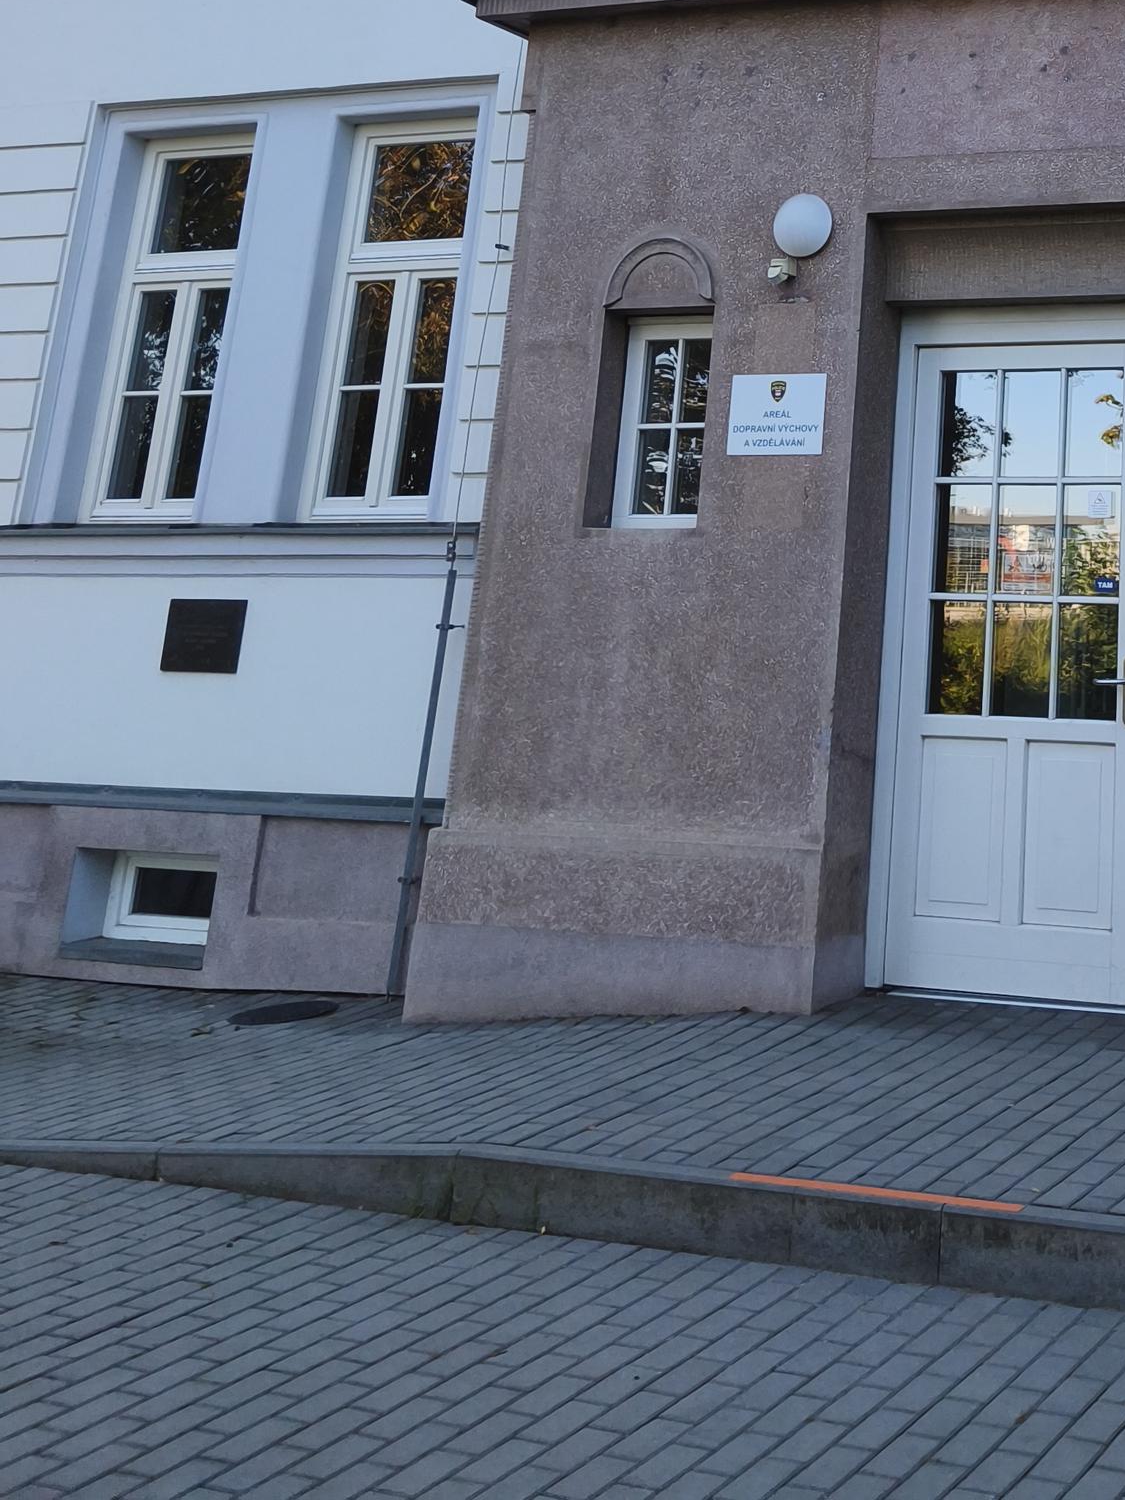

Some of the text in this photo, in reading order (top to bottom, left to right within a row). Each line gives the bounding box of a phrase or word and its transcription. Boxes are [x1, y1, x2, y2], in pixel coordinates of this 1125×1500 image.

[763, 410, 792, 418] AREÁL
[733, 423, 819, 433] DOPRAVNÍ VÝCHOVY
[744, 437, 805, 447] A VZDĚLÁVÁNÍ
